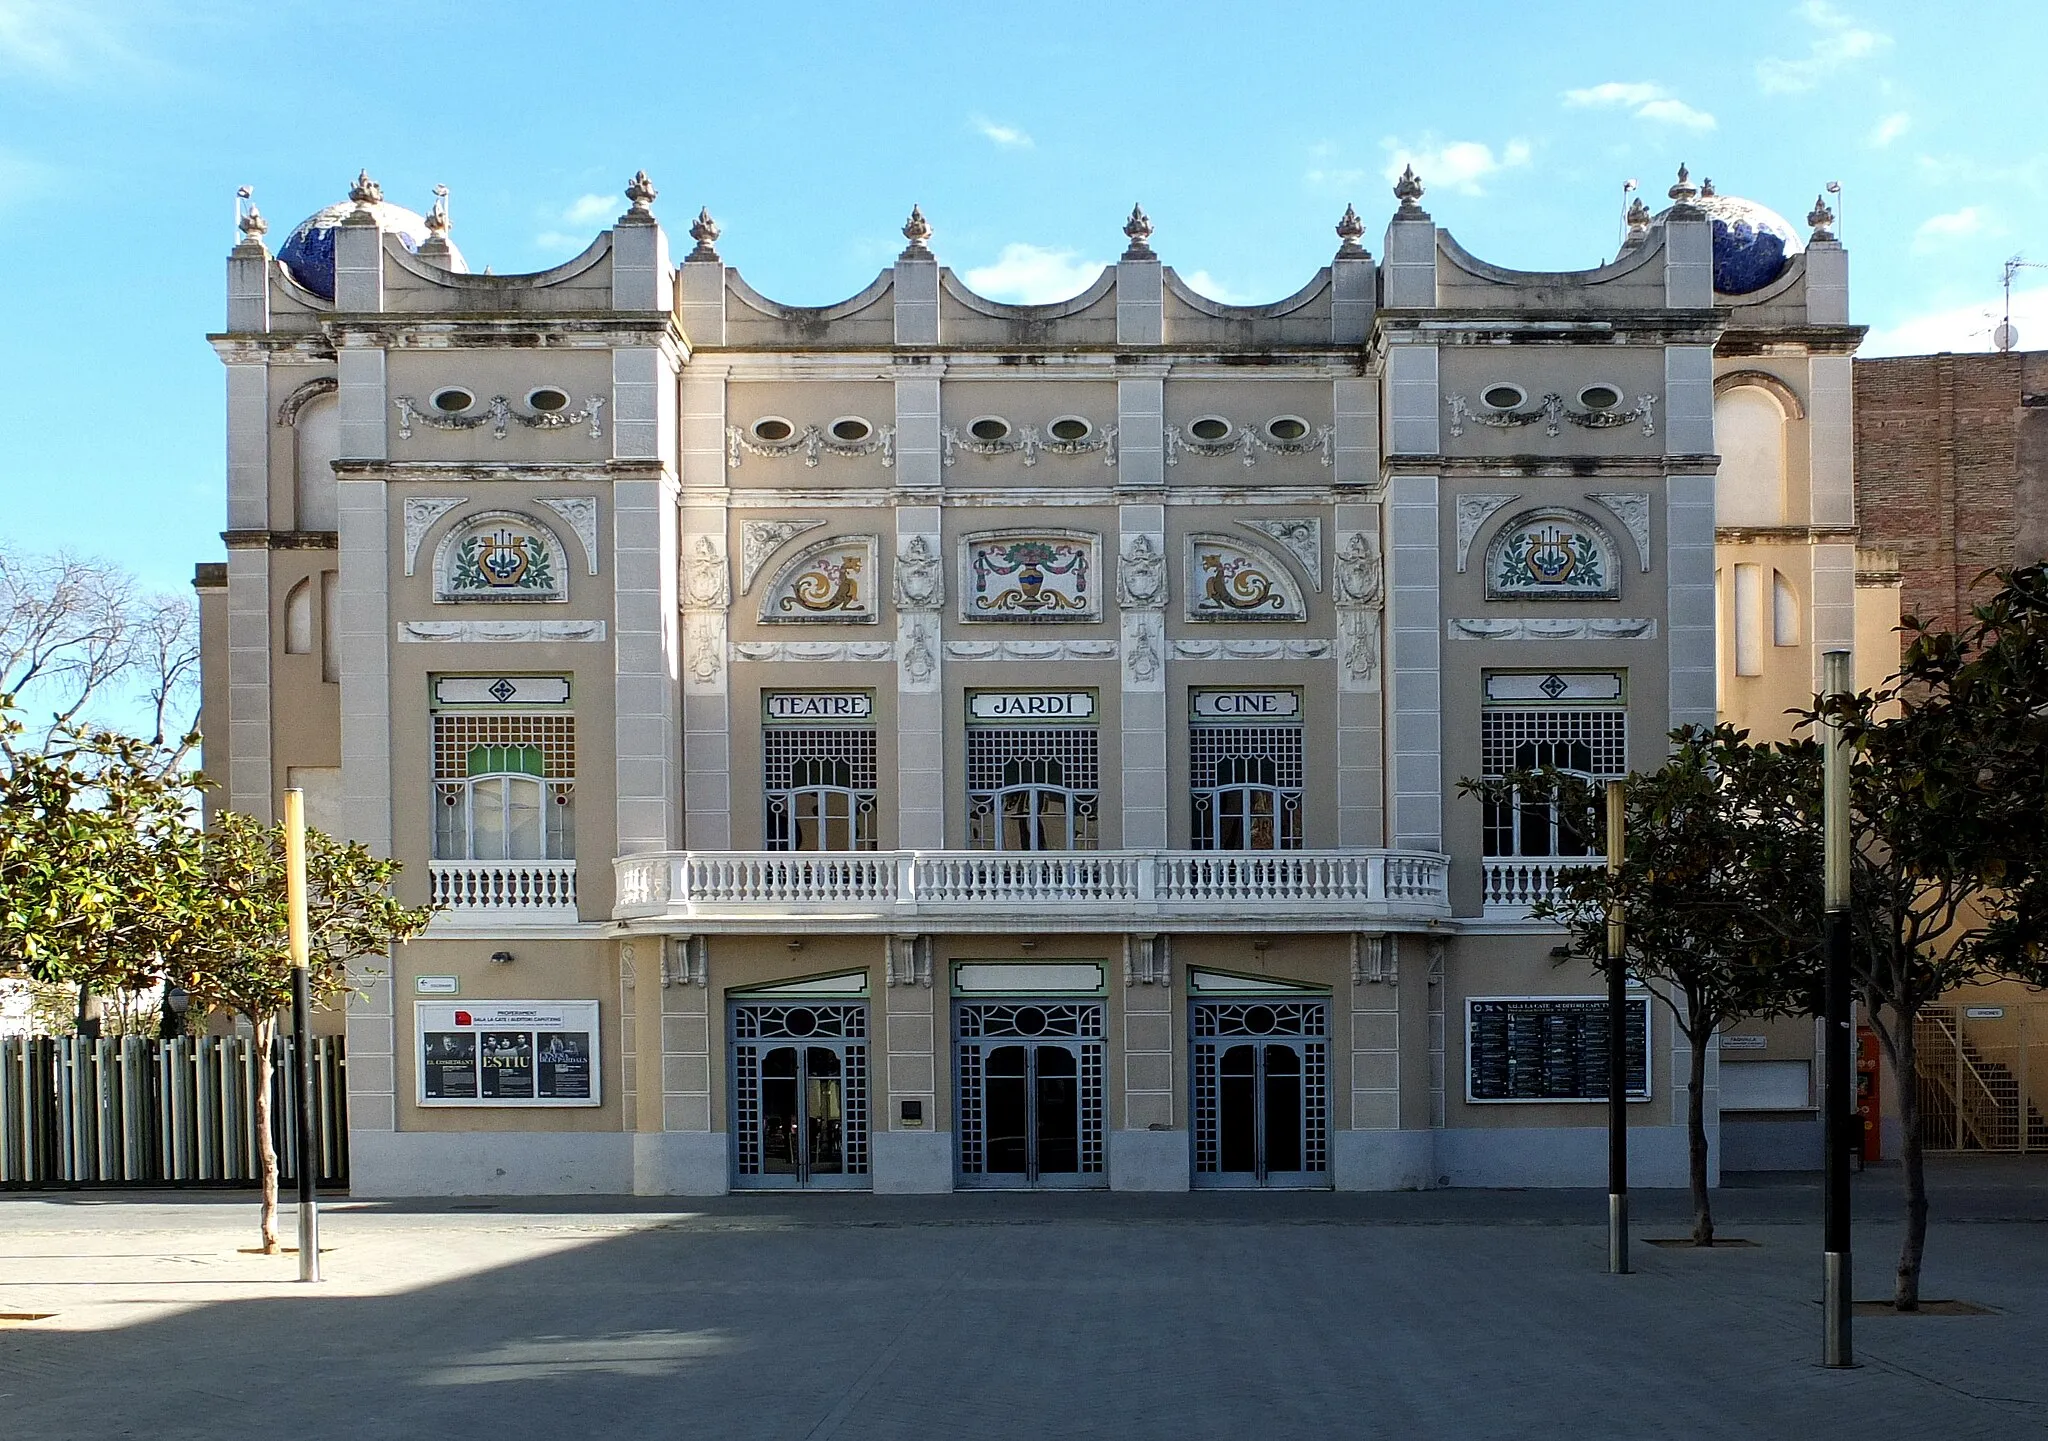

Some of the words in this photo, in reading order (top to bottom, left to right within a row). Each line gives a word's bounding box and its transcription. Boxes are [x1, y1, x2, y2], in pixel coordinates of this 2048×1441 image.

[775, 697, 865, 714] TEATRE
[994, 694, 1072, 714] JARDÍ
[1214, 695, 1278, 713] CINE
[483, 1056, 530, 1068] ESTIU
